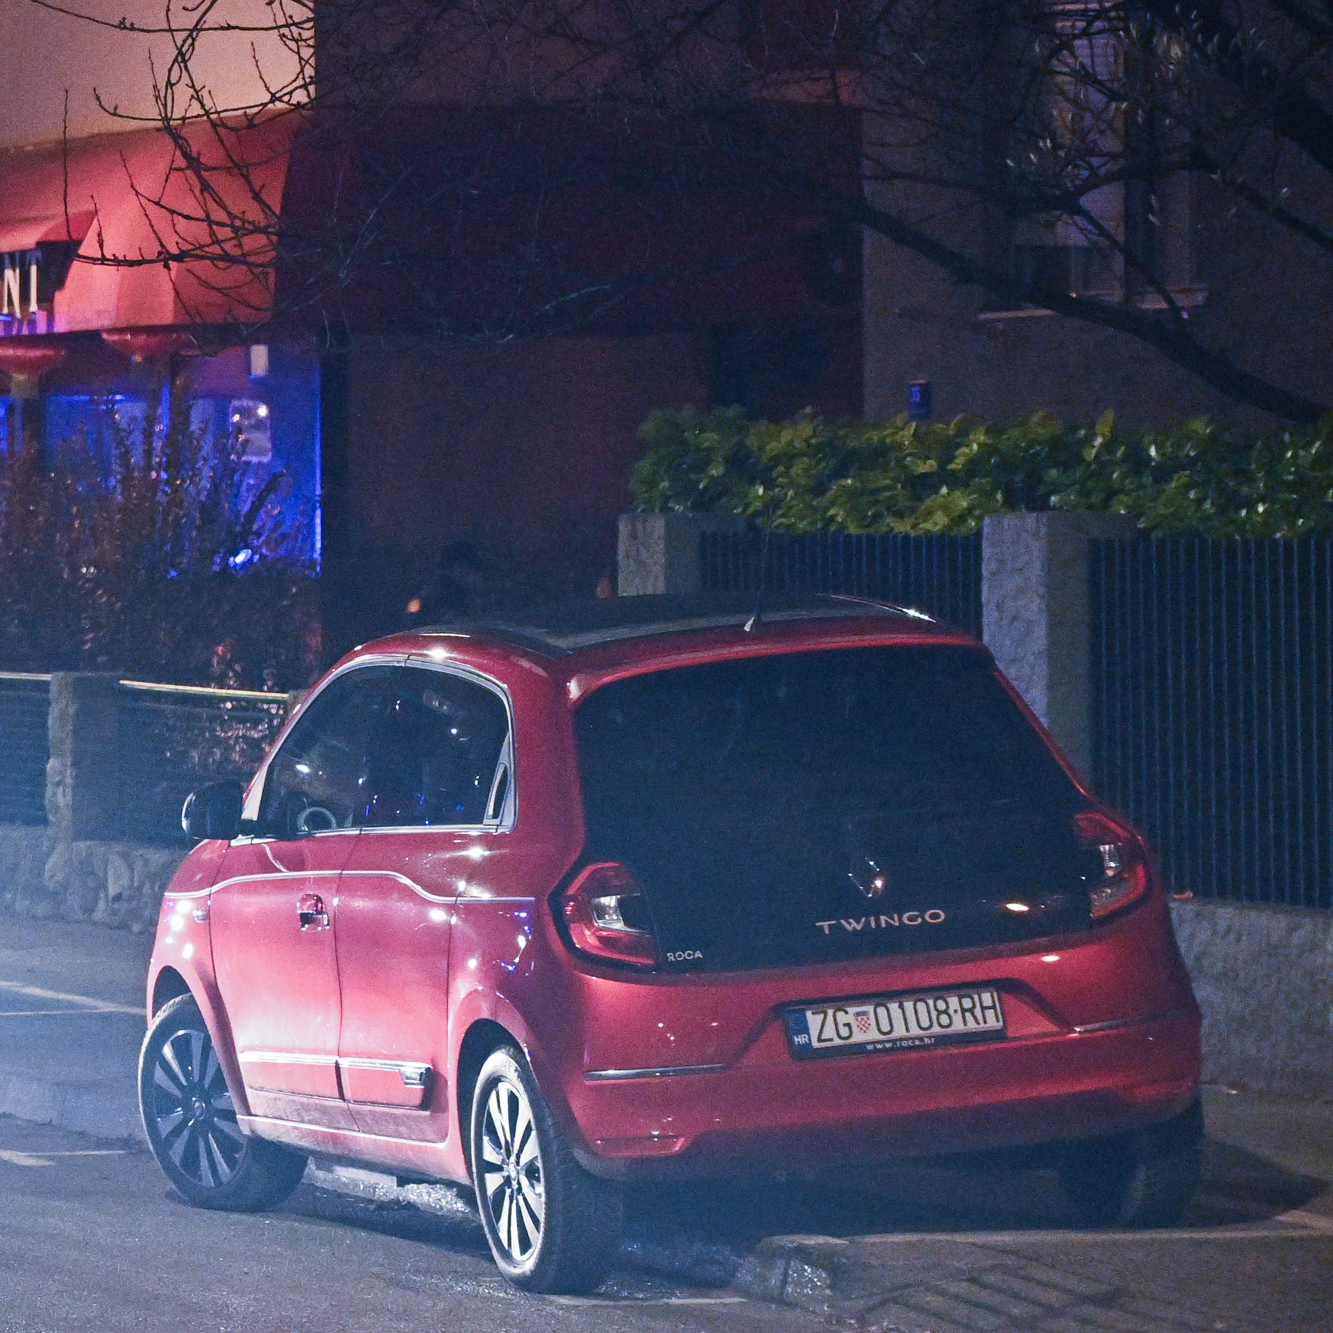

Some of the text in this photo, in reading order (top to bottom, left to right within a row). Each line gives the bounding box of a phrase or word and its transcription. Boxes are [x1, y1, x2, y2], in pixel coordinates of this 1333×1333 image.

[815, 909, 946, 935] TWINGO
[666, 950, 703, 962] ROCA
[810, 1007, 854, 1043] ZG
[793, 1033, 810, 1045] HR
[865, 1036, 937, 1051] www.roca.hr
